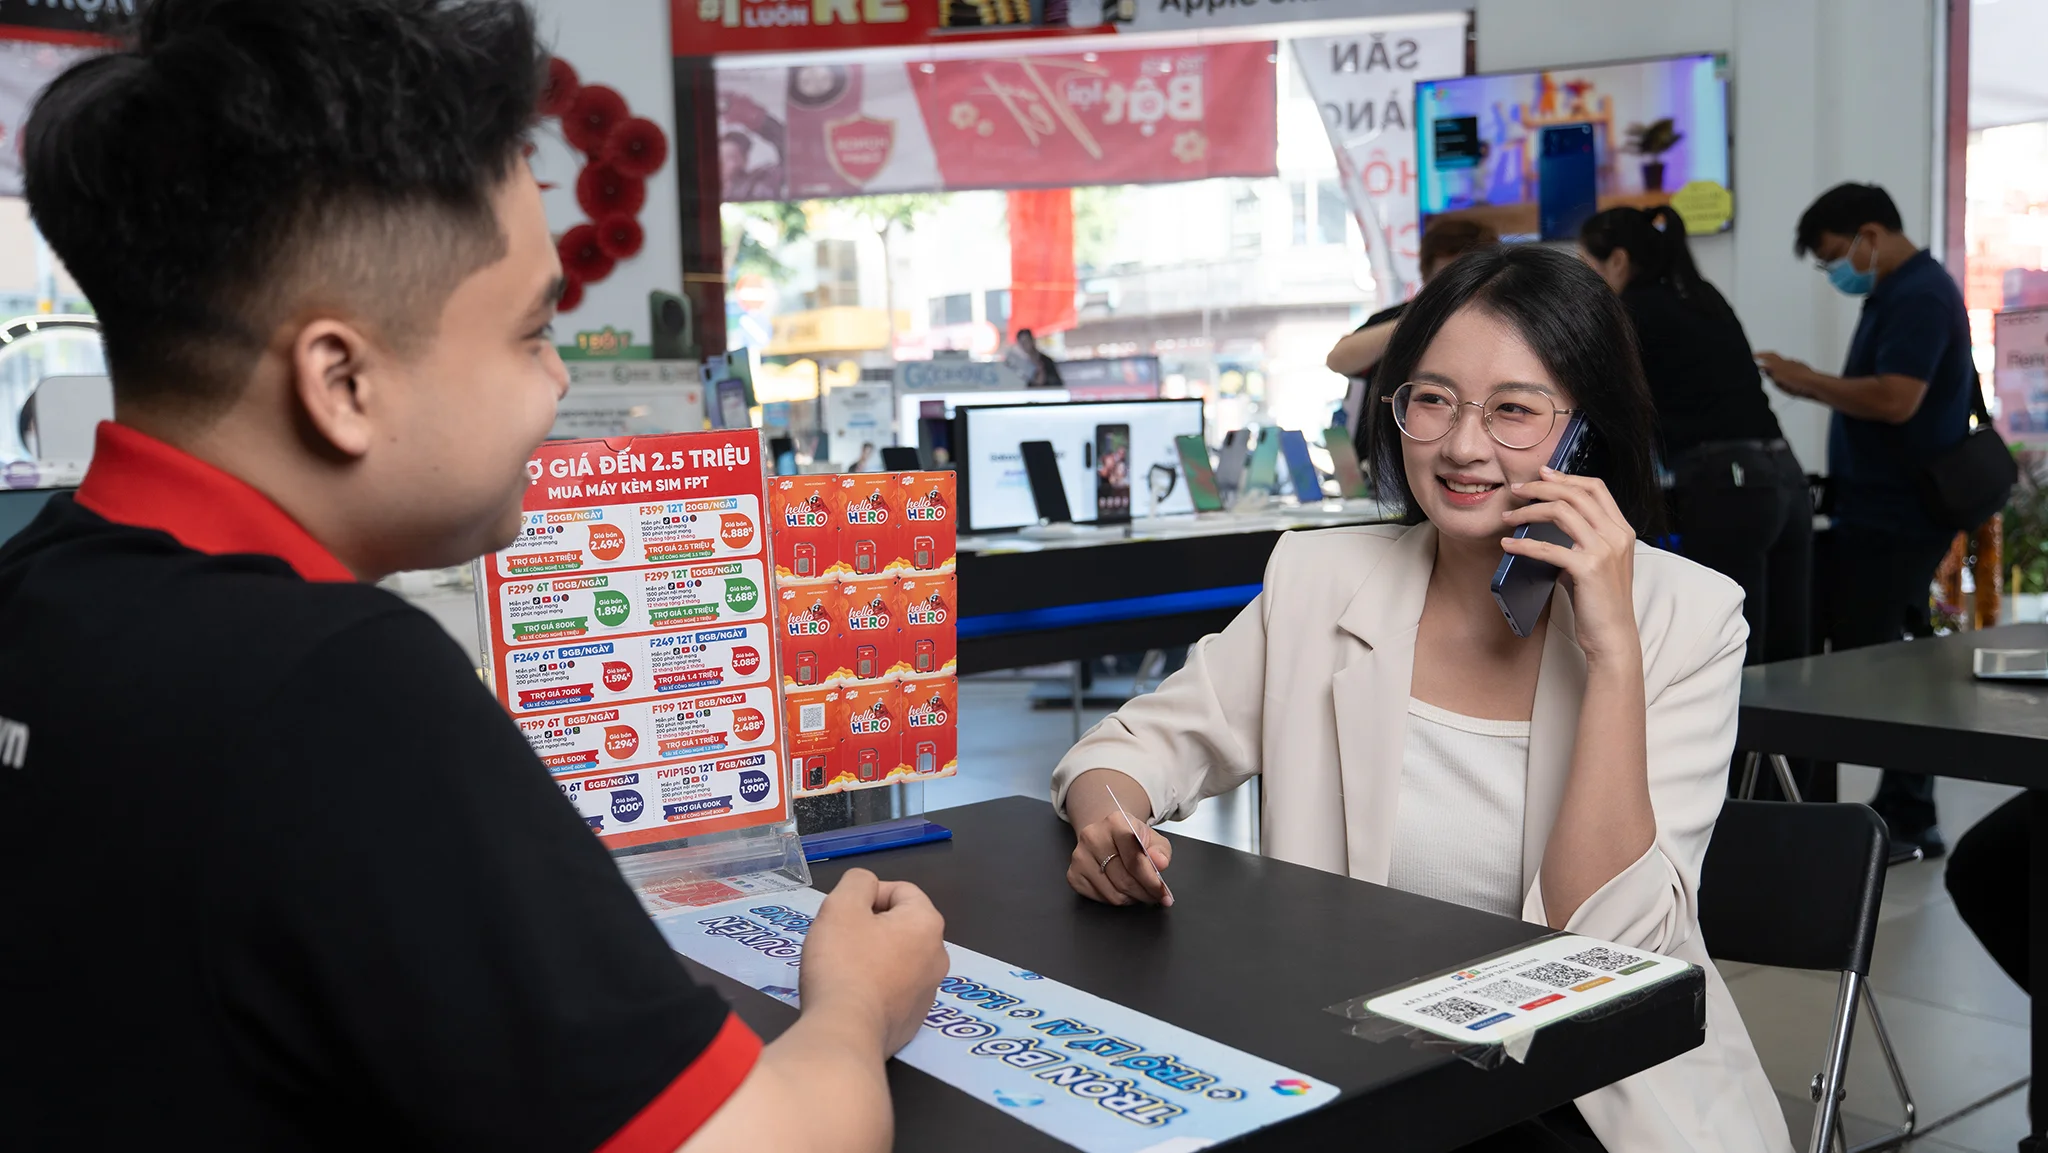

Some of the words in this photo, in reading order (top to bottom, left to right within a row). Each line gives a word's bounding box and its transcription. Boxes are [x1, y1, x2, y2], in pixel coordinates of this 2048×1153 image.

[743, 5, 809, 27] LUÔN
[550, 452, 594, 478] GIÁ
[599, 446, 645, 475] ĐẾN
[651, 451, 684, 471] 2.5
[689, 444, 750, 471] TRIỆU
[547, 486, 582, 500] MUA
[586, 481, 618, 498] MÁY
[621, 479, 652, 495] KÈM
[655, 477, 681, 492] SIM
[684, 475, 709, 489] FPT
[639, 505, 664, 515] F399
[667, 504, 683, 513] 12T
[686, 500, 736, 511] 20GB/NGÀY
[785, 502, 811, 514] hello
[847, 500, 873, 512] hello
[906, 497, 931, 509] hello
[531, 514, 544, 524] 6T
[548, 510, 601, 522] 20GB/NGÀY
[786, 512, 828, 527] HERO
[848, 509, 888, 525] HERO
[907, 506, 946, 521] HERO
[722, 527, 753, 538] 4.888K
[590, 538, 623, 550] 2.494K
[690, 542, 710, 550] TRIỆU
[512, 558, 528, 566] TRỢ
[555, 554, 577, 562] TRIỆU
[645, 572, 669, 581] F299
[671, 570, 688, 579] 12T
[692, 565, 741, 576] 10GB/NGÀY
[508, 584, 534, 595] F299
[537, 583, 549, 592] 6T
[554, 578, 606, 590] 10GB/NGÀY
[727, 591, 756, 603] 3.688K
[596, 605, 628, 616] 1.894K
[654, 612, 668, 620] TRỢ
[695, 607, 714, 615] TRIỆU
[848, 606, 873, 618] hello
[907, 601, 932, 613] hello
[788, 611, 813, 623] hello
[849, 614, 890, 631] HERO
[908, 609, 947, 625] HERO
[524, 625, 540, 633] TRỢ
[541, 622, 554, 631] GIÁ
[788, 619, 830, 636] HERO
[650, 637, 674, 647] F249
[677, 635, 693, 644] 12T
[699, 630, 743, 641] 9GB/NGÀY
[513, 653, 539, 663] F249
[542, 650, 555, 660] 6T
[562, 645, 610, 657] 9GB/NGÀY
[733, 657, 759, 668] 3.088K
[605, 673, 630, 683] 1.594K
[698, 671, 718, 680] TRIỆU
[530, 692, 546, 700] TRỢ
[562, 688, 581, 696] 700K
[652, 703, 675, 714] F199
[678, 701, 693, 710] 12T
[698, 696, 742, 707] 8GB/NGÀY
[908, 703, 932, 715] hello
[520, 720, 544, 731] F199
[548, 718, 560, 728] 6T
[568, 712, 615, 725] 8GB/NGÀY
[851, 709, 876, 722] hello
[908, 711, 948, 727] HERO
[734, 720, 763, 733] 2.488K
[851, 717, 891, 735] HERO
[607, 738, 636, 750] 1.294K
[666, 742, 681, 750] TRỢ
[699, 736, 719, 744] TRIỆU
[553, 757, 565, 765] GIÁ
[657, 766, 696, 779] FVIP150
[699, 763, 715, 772] 12T
[719, 756, 763, 770] 7GB/NGÀY
[569, 782, 581, 792] 6T
[588, 776, 635, 789] 6GB/NGÀY
[741, 783, 768, 794] 1.900K
[612, 801, 643, 814] 1.000K
[674, 807, 689, 815] TRỢ
[1029, 1017, 1102, 1038] AI
[968, 1037, 1068, 1069] BỘ
[1064, 1036, 1143, 1059] LÝ
[1110, 1054, 1220, 1093] TRỢ
[1031, 1063, 1190, 1128] TRỌN
